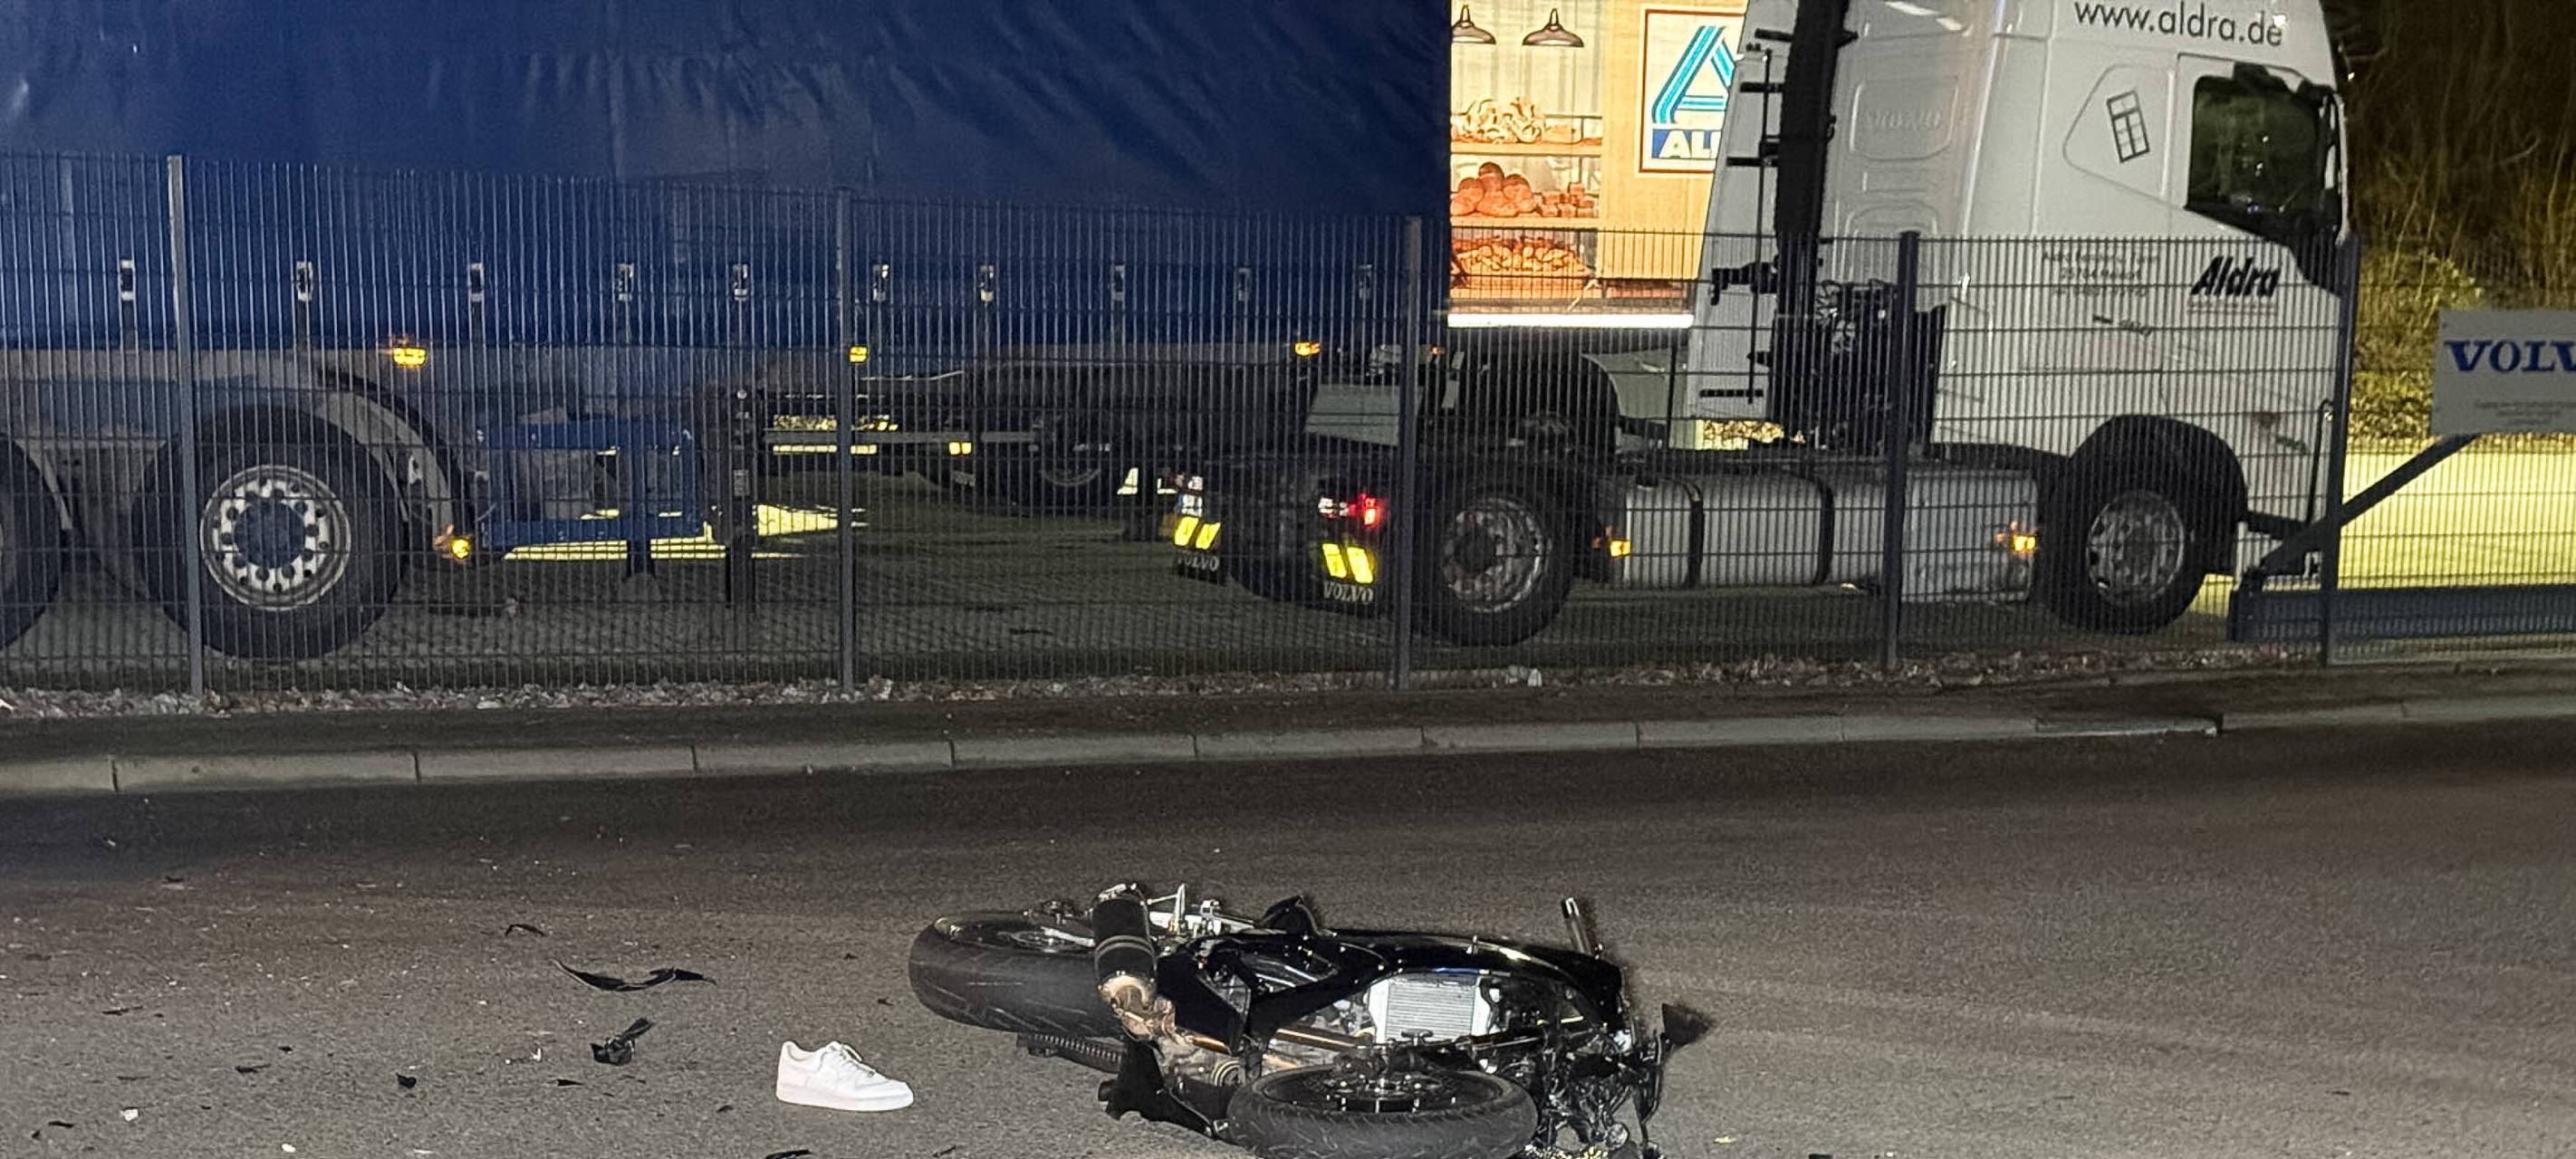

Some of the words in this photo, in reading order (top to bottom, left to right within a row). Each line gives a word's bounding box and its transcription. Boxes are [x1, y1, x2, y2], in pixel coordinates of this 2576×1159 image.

[2074, 2, 2283, 46] www.aldra.de
[2190, 255, 2281, 296] Aldra
[1323, 580, 1373, 605] VOLVO
